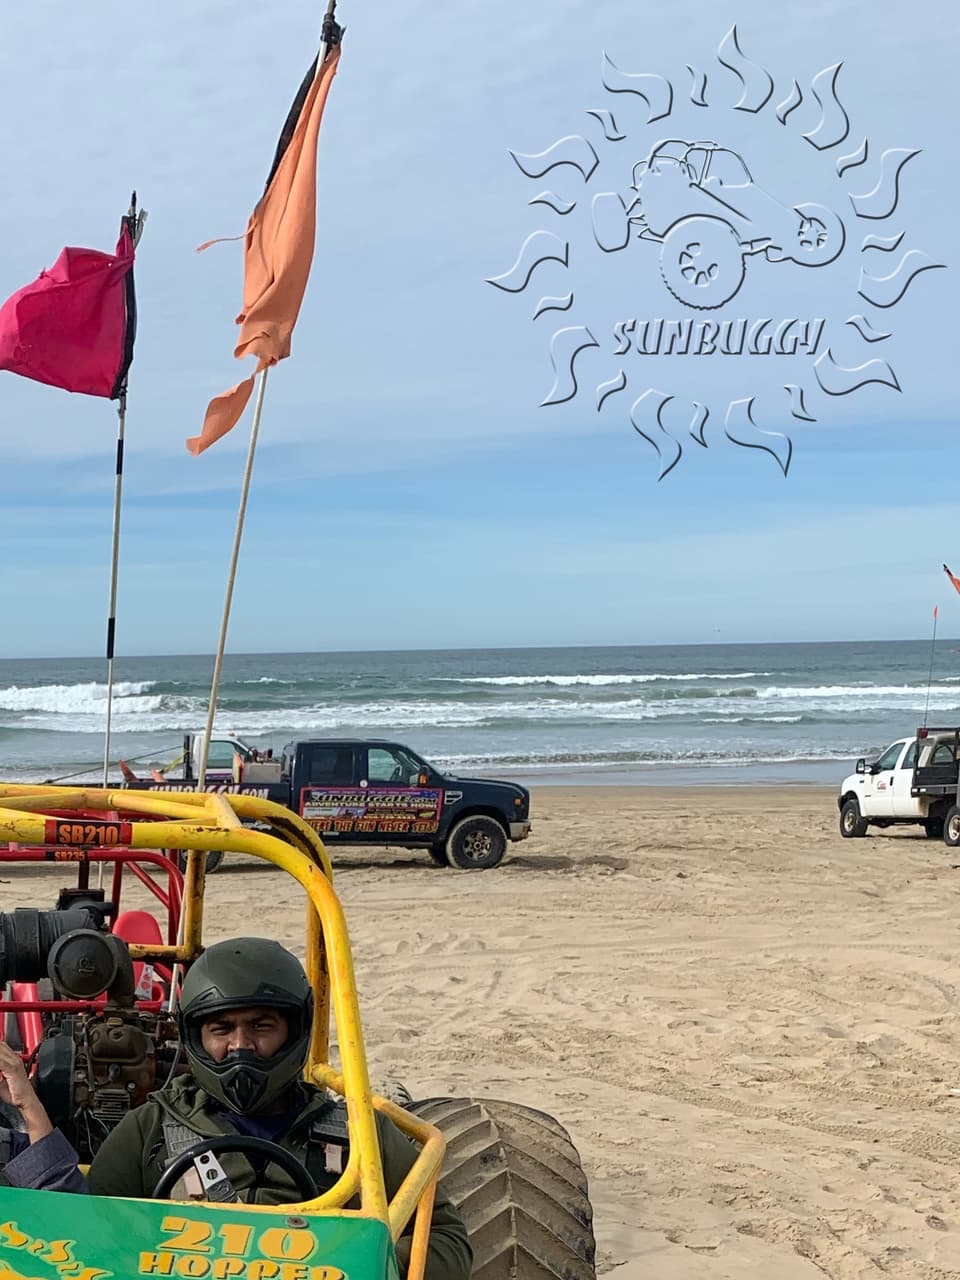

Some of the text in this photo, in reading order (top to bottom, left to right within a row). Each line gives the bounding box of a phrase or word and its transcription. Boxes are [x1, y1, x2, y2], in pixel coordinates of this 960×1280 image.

[59, 824, 119, 845] SB210
[335, 821, 353, 831] THE
[355, 821, 376, 832] FUN
[378, 821, 409, 832] NEVER
[54, 850, 86, 861] SB235
[157, 1216, 319, 1261] 210
